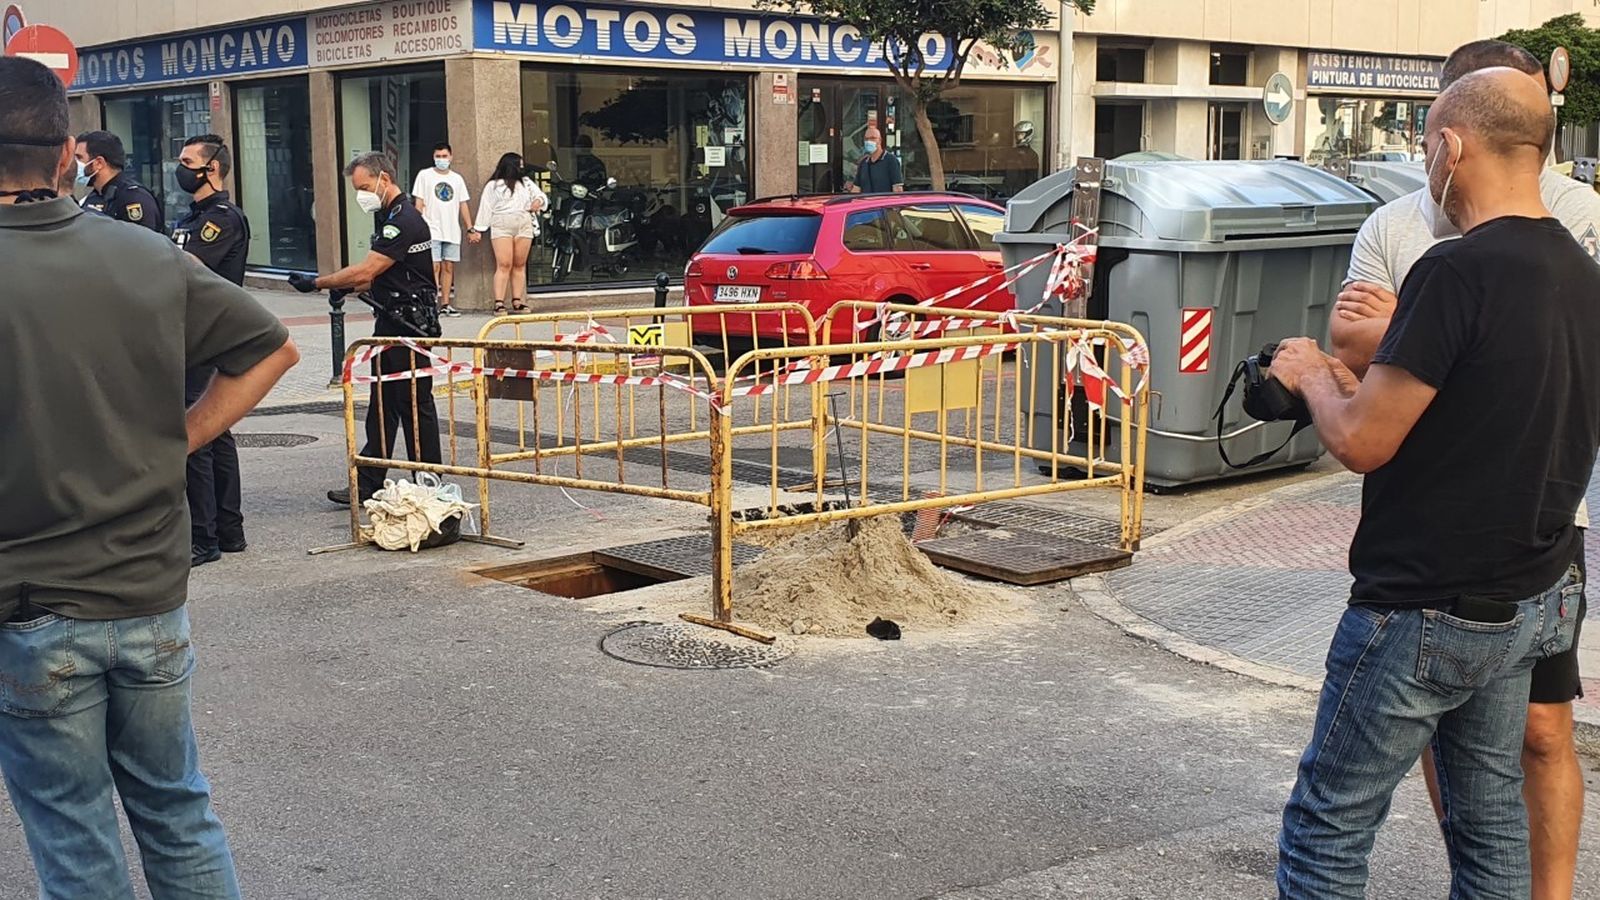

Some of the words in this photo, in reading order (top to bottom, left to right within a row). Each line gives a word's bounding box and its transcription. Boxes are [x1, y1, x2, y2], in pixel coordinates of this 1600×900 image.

[315, 8, 382, 29] MOTOCICLETAS
[392, 0, 452, 19] BOUTIQUE
[315, 25, 385, 46] CICLOMOTORES
[393, 15, 458, 37] RECAMBIOS
[492, 1, 697, 56] MOTOS
[161, 24, 295, 76] MONCAYO
[316, 44, 372, 63] BICICLETAS
[394, 34, 462, 55] ACCESORIOS
[1312, 54, 1382, 70] ASISTENCIA
[1388, 58, 1433, 73] TECNICA
[1311, 70, 1356, 85] PINTURA
[1360, 72, 1373, 86] DE
[1376, 73, 1440, 89] MOTOCICLETA
[719, 286, 739, 298] 3496
[740, 287, 759, 298] HXN
